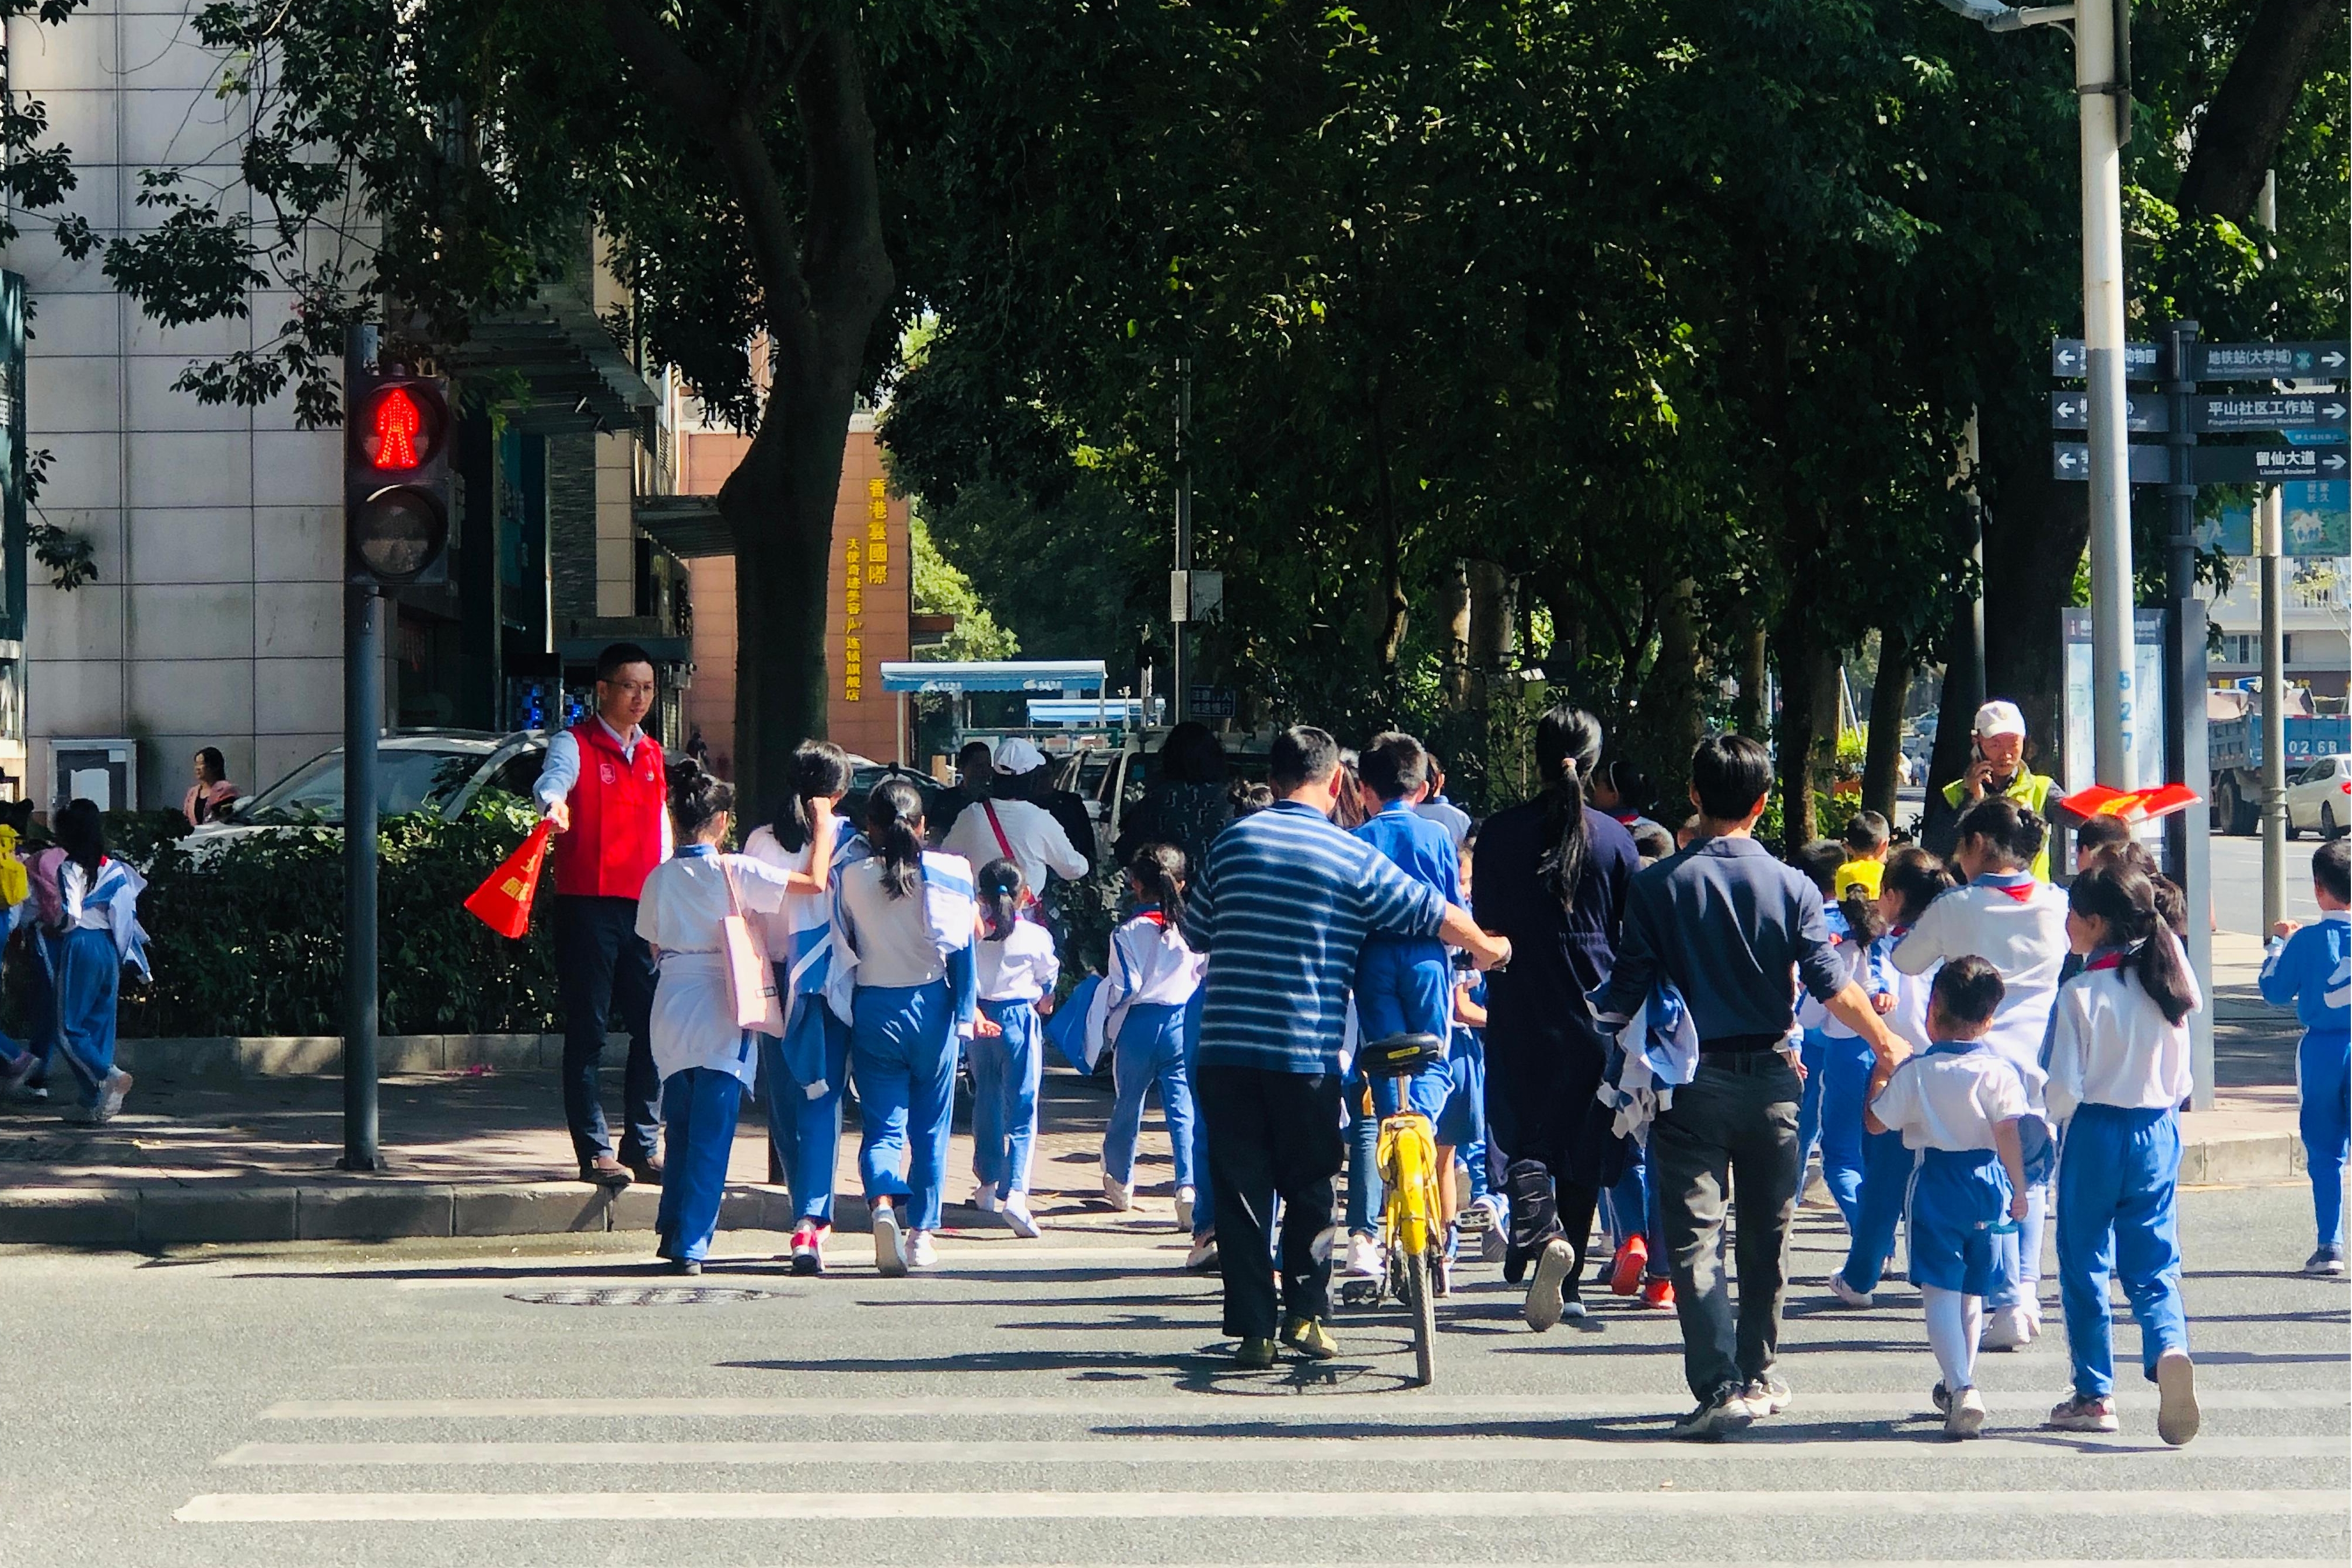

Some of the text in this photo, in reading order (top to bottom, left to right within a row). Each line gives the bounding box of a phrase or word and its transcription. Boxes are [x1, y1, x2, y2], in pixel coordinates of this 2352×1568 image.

[2208, 349, 2292, 365] 地铁站(大学城)
[2208, 400, 2315, 416] 平山社区工作站
[2256, 450, 2315, 466] 留仙大道
[2120, 671, 2132, 752] 527
